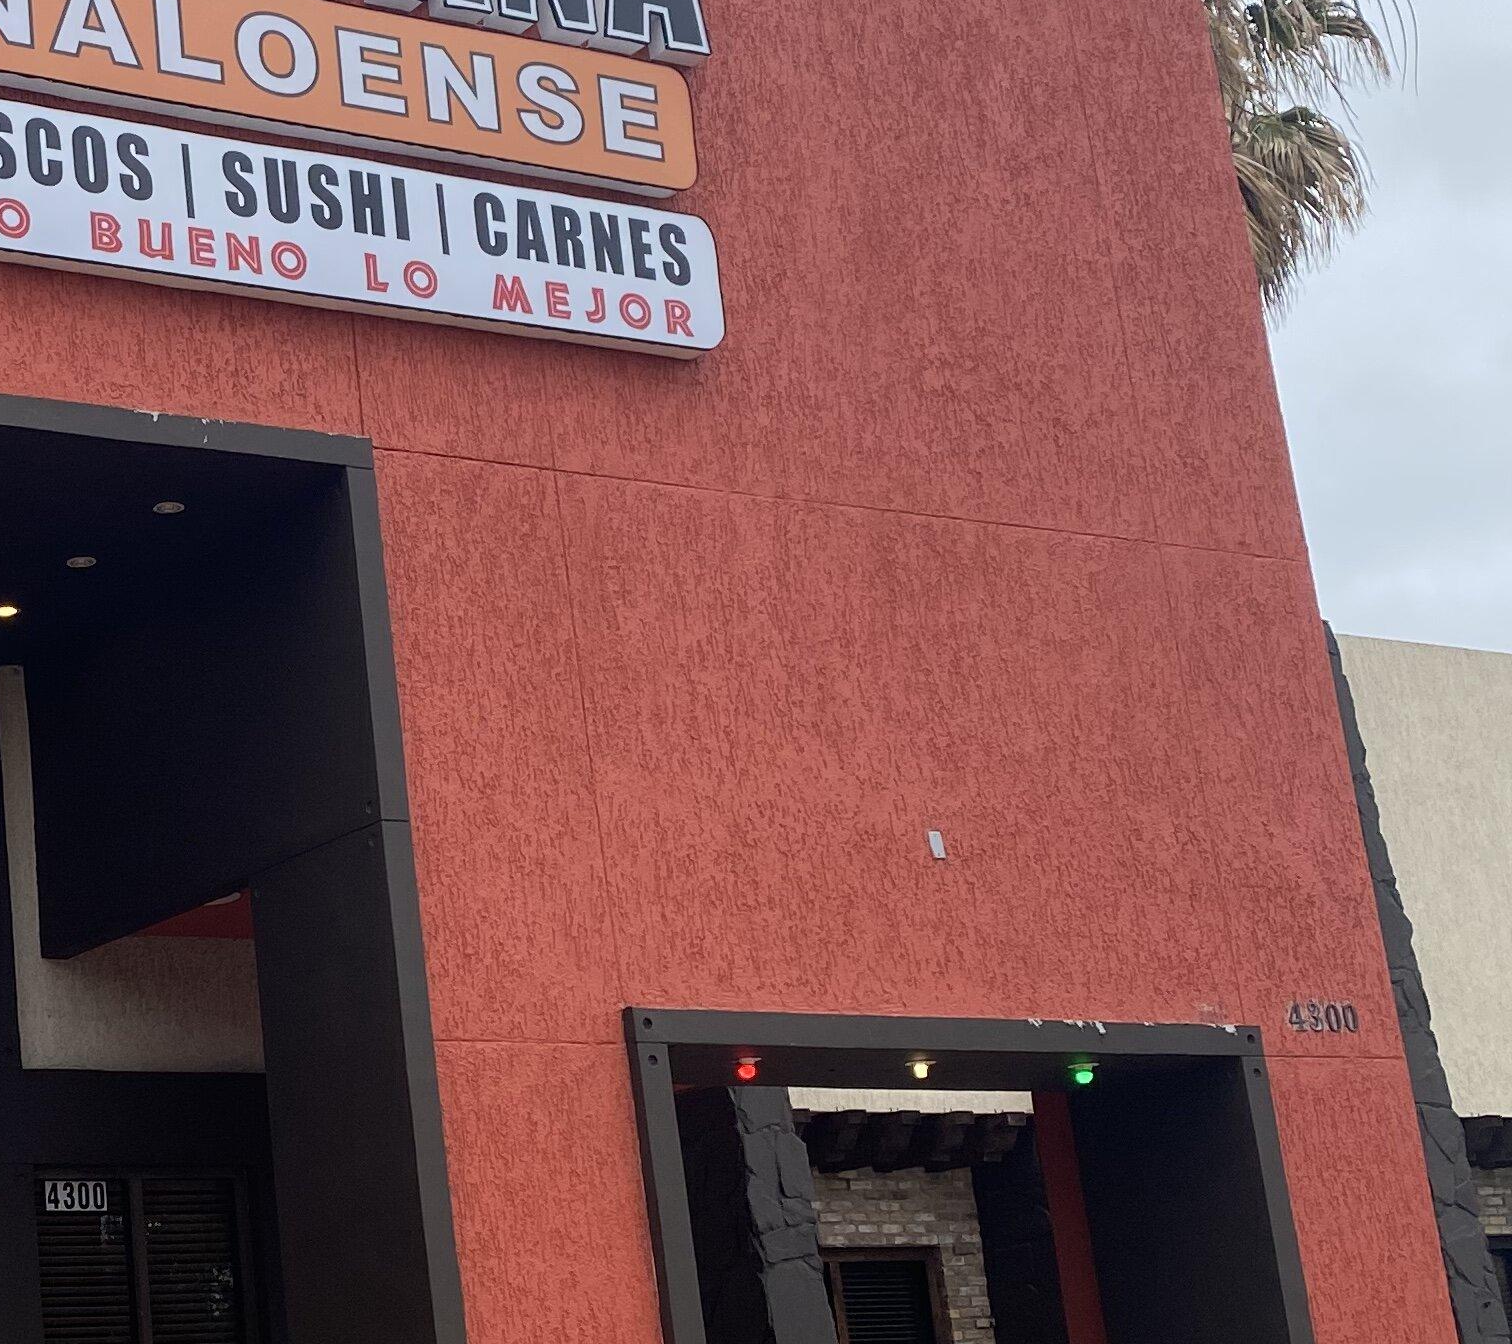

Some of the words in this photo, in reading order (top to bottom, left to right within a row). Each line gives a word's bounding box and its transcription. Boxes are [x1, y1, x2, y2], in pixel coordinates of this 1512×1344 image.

[222, 150, 411, 241] SUSHI
[473, 192, 692, 286] CARNES
[89, 210, 308, 281] BUENO
[364, 252, 439, 299] LO
[492, 273, 695, 338] MEJOR
[1288, 1000, 1359, 1033] 4300
[47, 1181, 105, 1210] 4300
